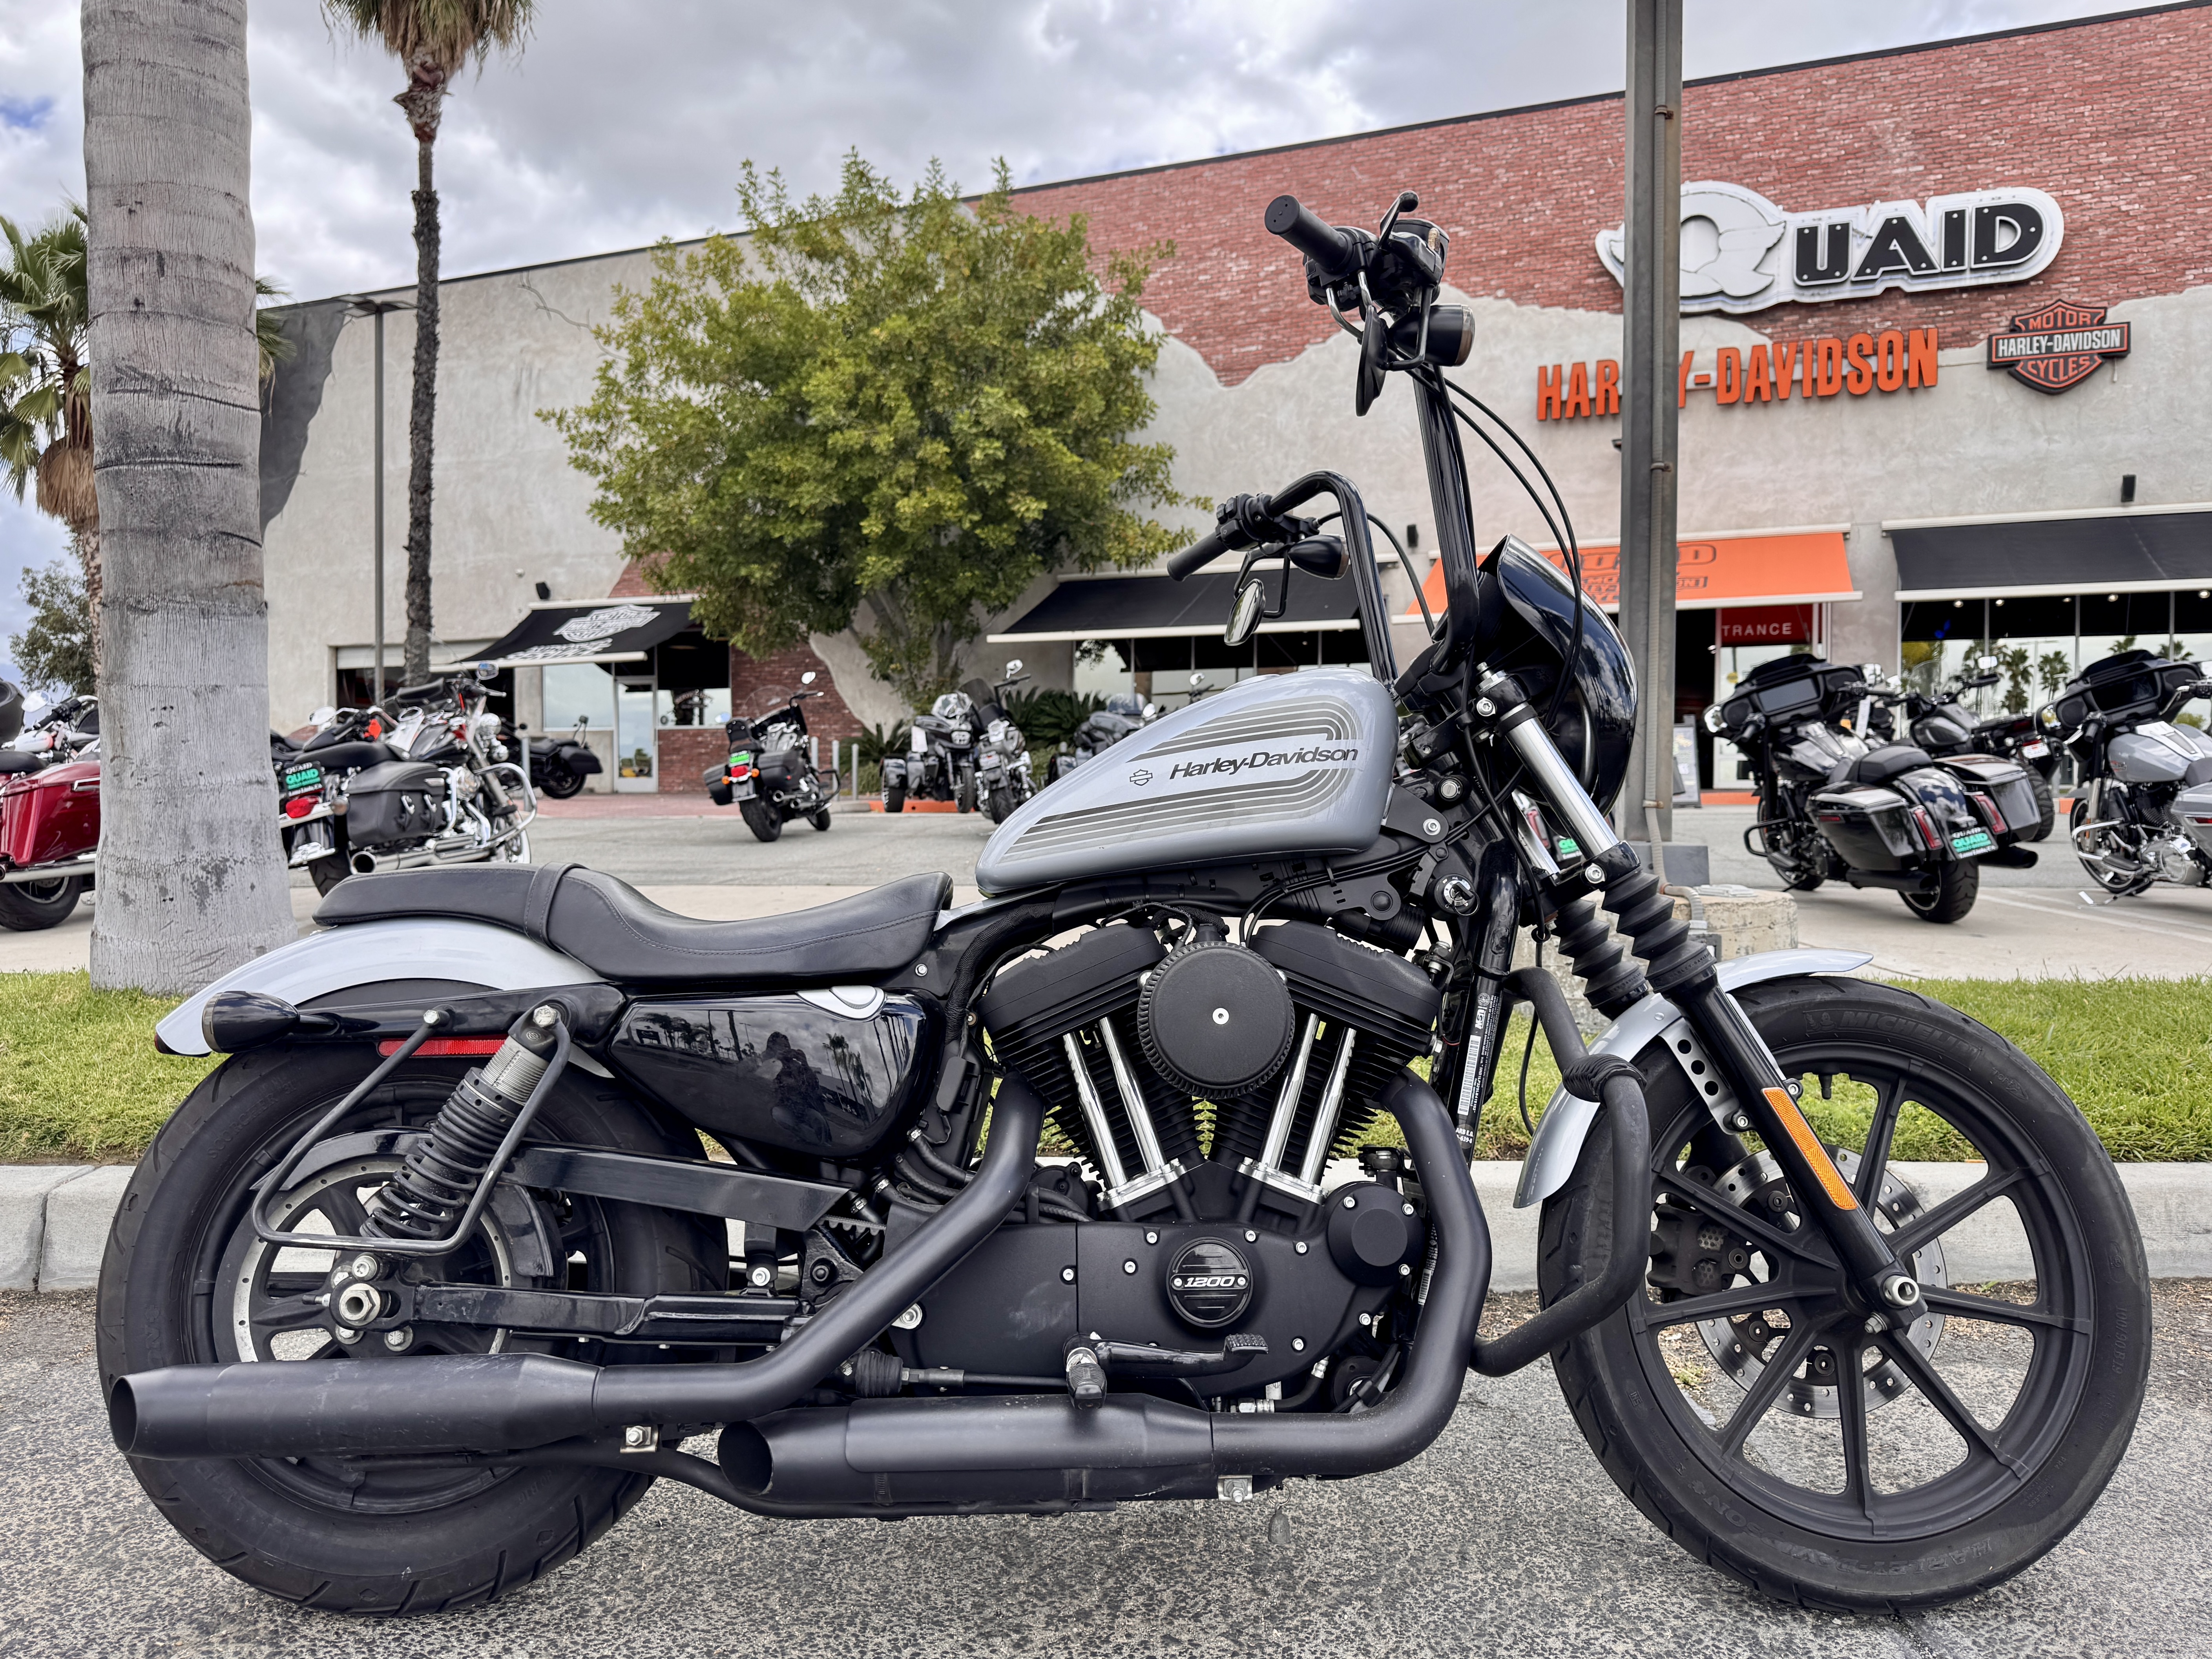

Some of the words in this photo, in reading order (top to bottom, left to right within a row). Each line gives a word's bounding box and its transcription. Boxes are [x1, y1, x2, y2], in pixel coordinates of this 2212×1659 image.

[2029, 307, 2091, 330] MOTOR
[1997, 329, 2121, 357] HARLEY-DAVIDSON
[1537, 328, 1938, 421] HARY-DAVIDSON
[2027, 356, 2091, 382] CYCLES
[1170, 746, 1358, 779] Harley-Davidson
[286, 768, 319, 785] QUAID
[1952, 832, 1988, 848] QUAID
[1840, 1011, 1977, 1057] MICHELIN
[1184, 1276, 1235, 1287] 1200
